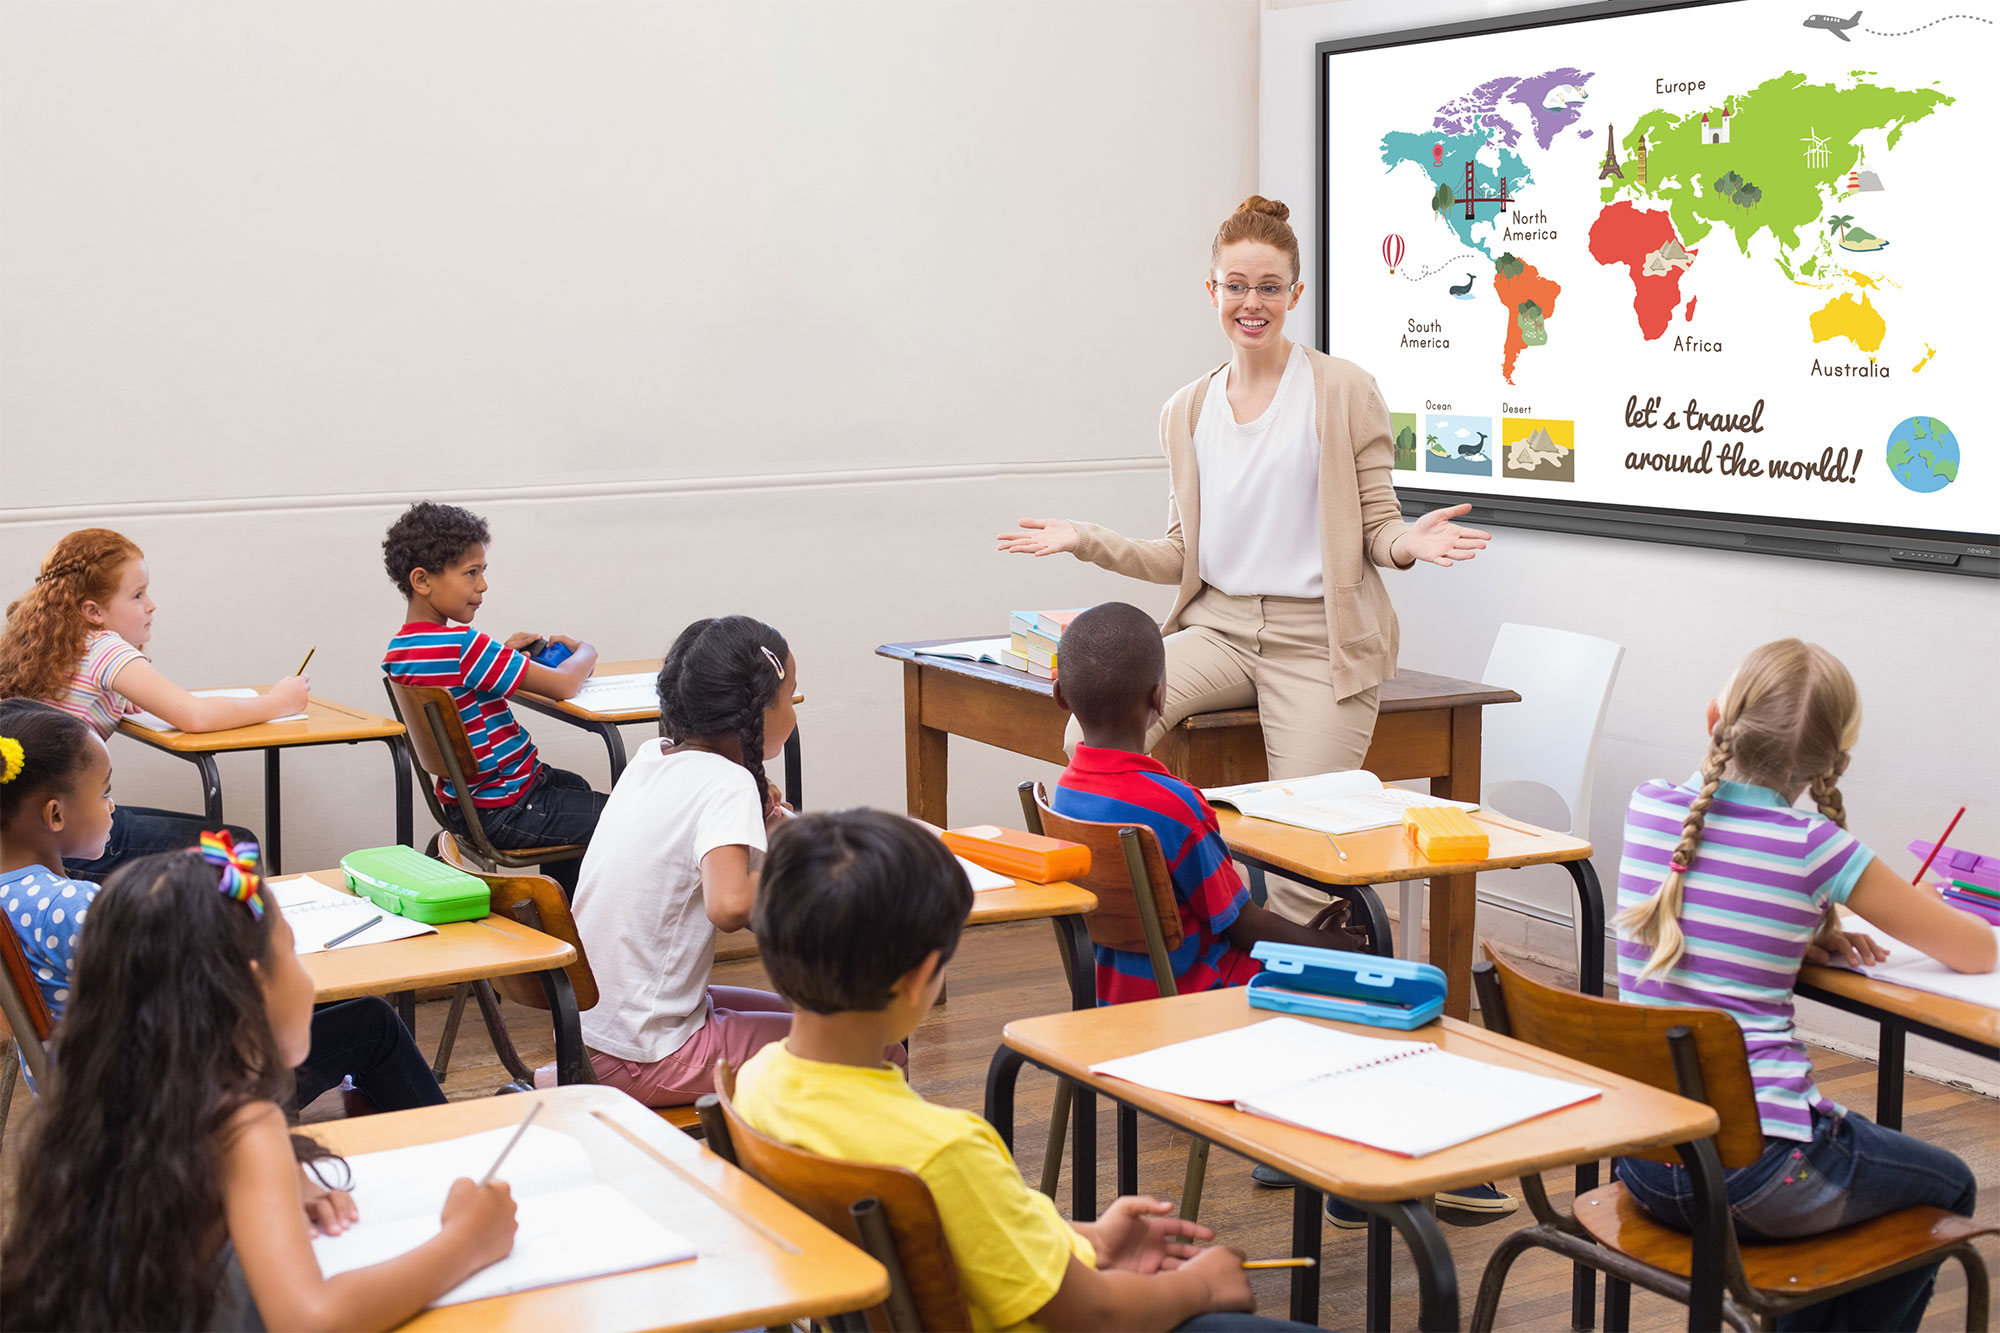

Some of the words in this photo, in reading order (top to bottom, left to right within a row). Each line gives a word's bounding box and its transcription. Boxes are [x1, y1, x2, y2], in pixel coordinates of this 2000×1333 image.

[1655, 77, 1706, 96] Europe
[1512, 209, 1547, 225] North
[1503, 226, 1558, 241] America
[1407, 318, 1442, 334] South
[1400, 334, 1450, 350] America
[1673, 335, 1722, 353] Africa
[1810, 359, 1890, 378] Australia
[1425, 399, 1452, 411] Ocean
[1502, 402, 1532, 414] Desert
[1625, 394, 1680, 430] let's
[1683, 399, 1765, 433] travel
[1624, 439, 1713, 474] around
[1716, 441, 1764, 477] the
[1768, 446, 1863, 484] world!
[1966, 546, 1991, 556] newline
